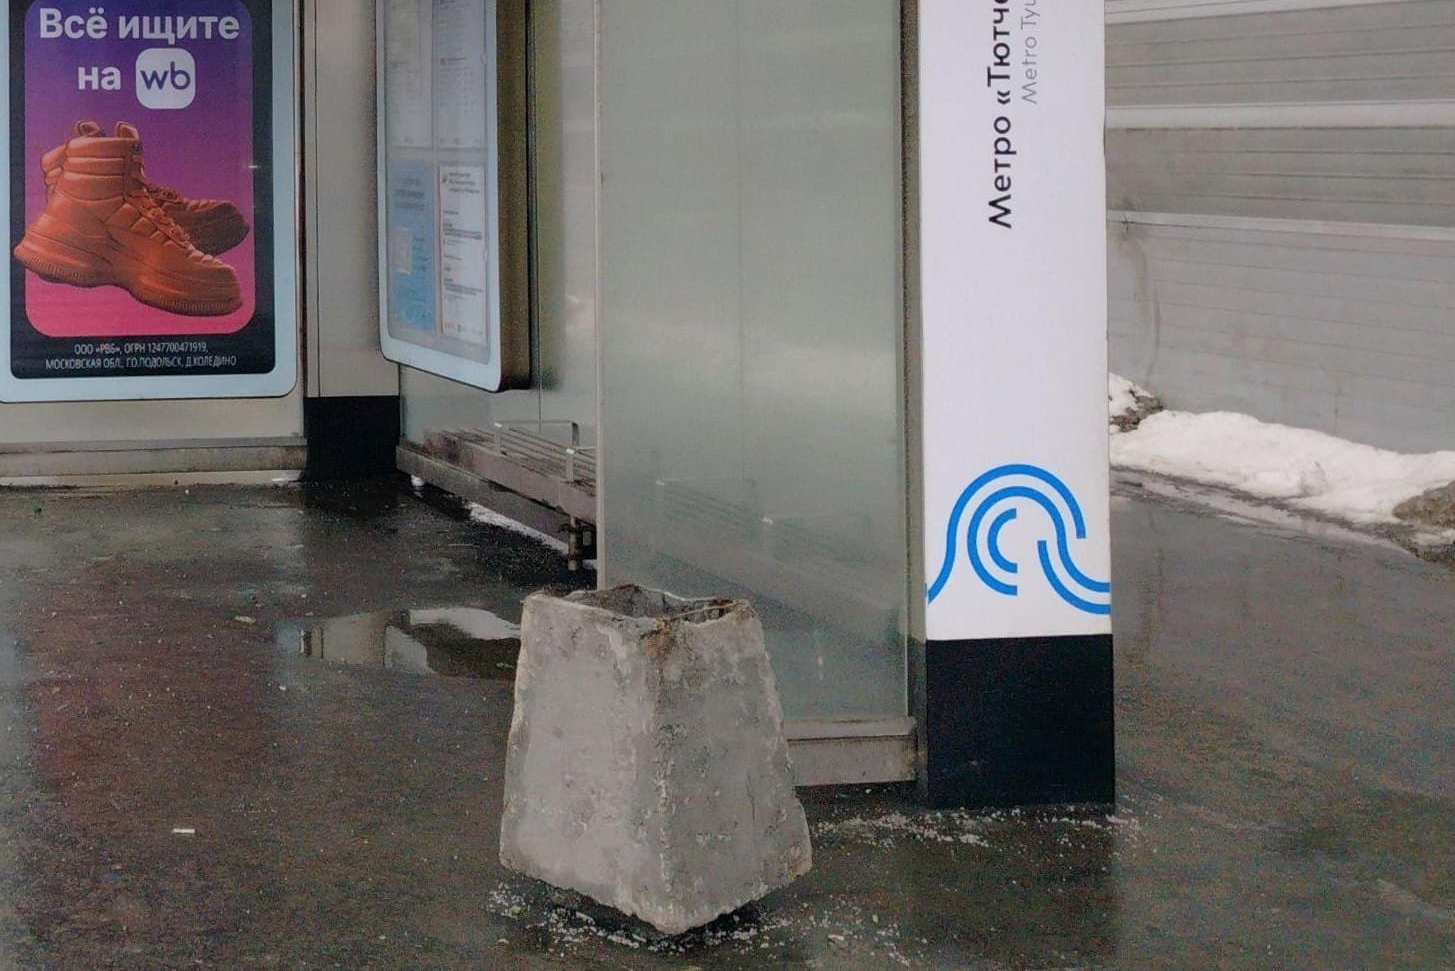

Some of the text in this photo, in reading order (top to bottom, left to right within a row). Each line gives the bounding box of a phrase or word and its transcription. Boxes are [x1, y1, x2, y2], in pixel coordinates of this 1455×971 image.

[39, 7, 240, 45] Всё ищите
[78, 61, 191, 90] на wb
[1021, 36, 1038, 104] Metro
[987, 116, 1017, 229] Метро
[45, 358, 102, 370] МОСКОВСКАЯ
[74, 343, 94, 355] ООО
[124, 342, 146, 354] ОГРН
